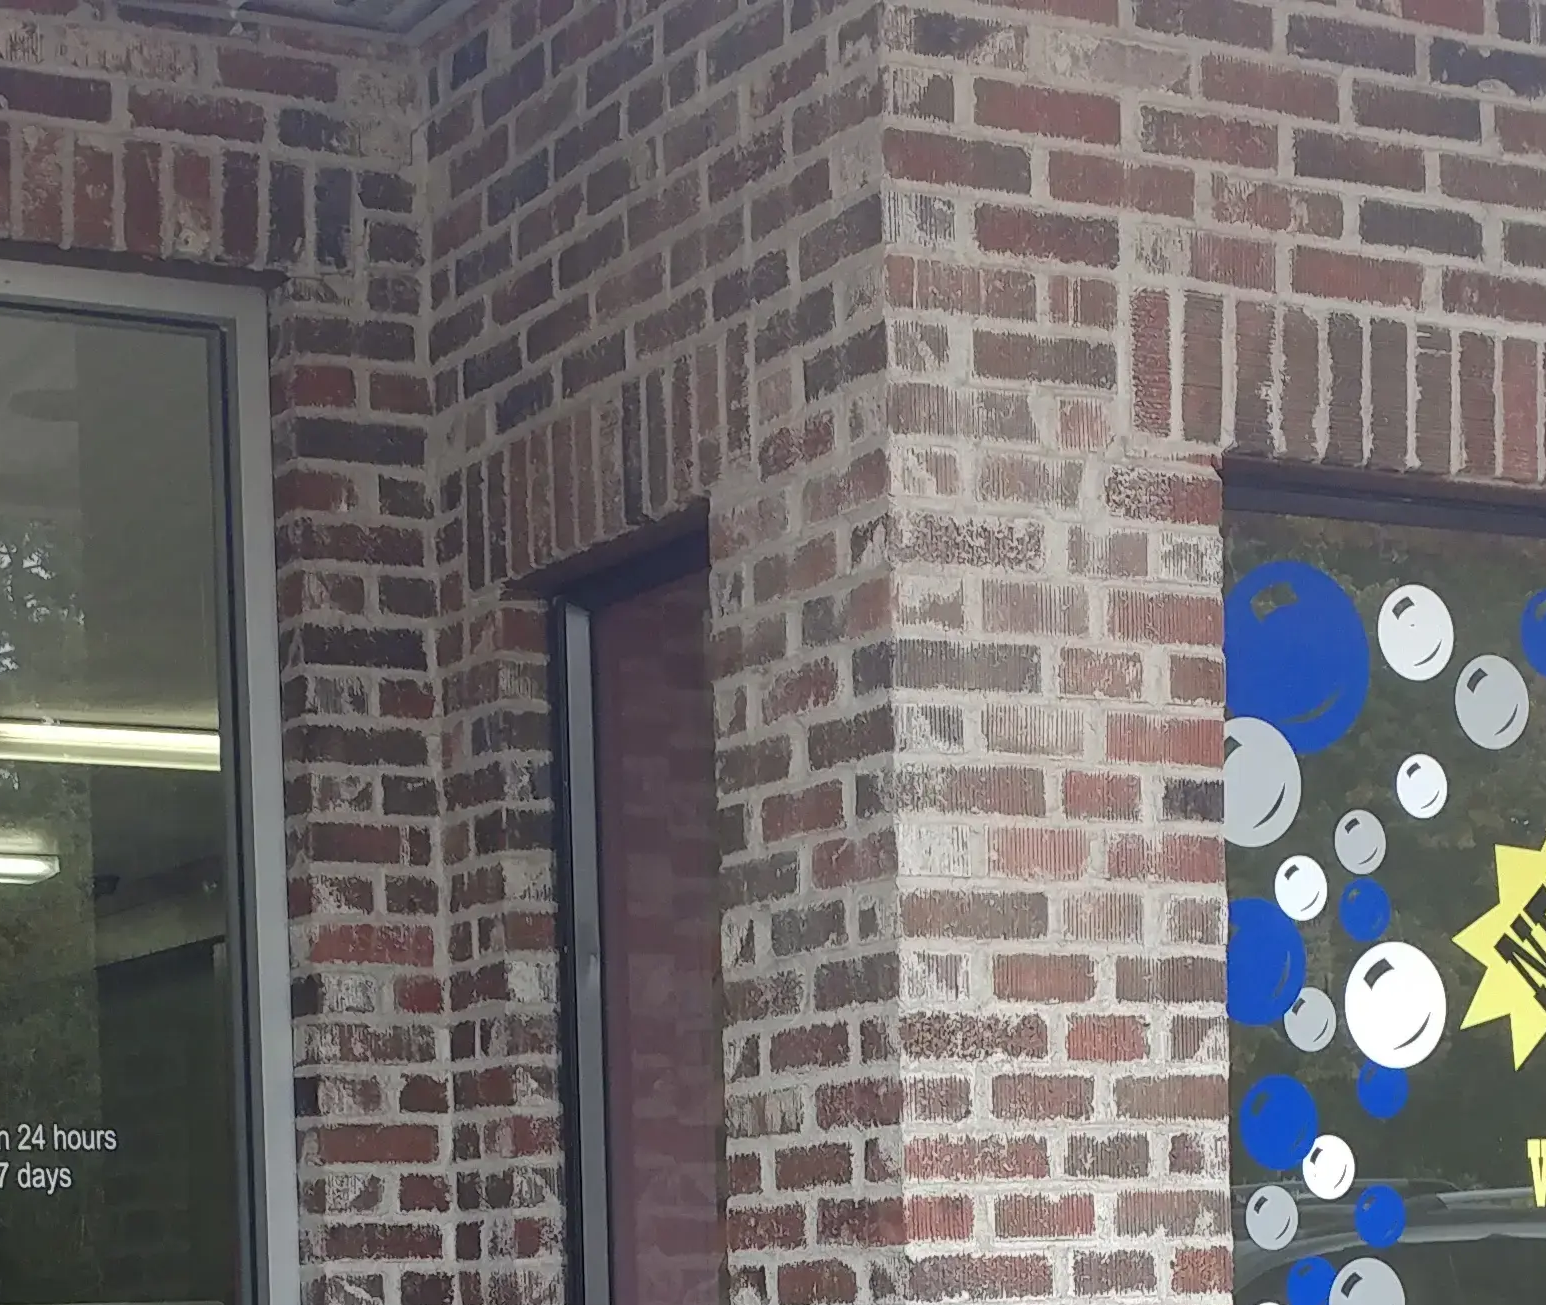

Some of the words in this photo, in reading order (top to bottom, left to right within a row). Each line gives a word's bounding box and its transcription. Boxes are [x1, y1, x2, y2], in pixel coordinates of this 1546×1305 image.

[17, 1123, 46, 1150] 24
[53, 1123, 117, 1151] hours
[17, 1161, 72, 1195] days
